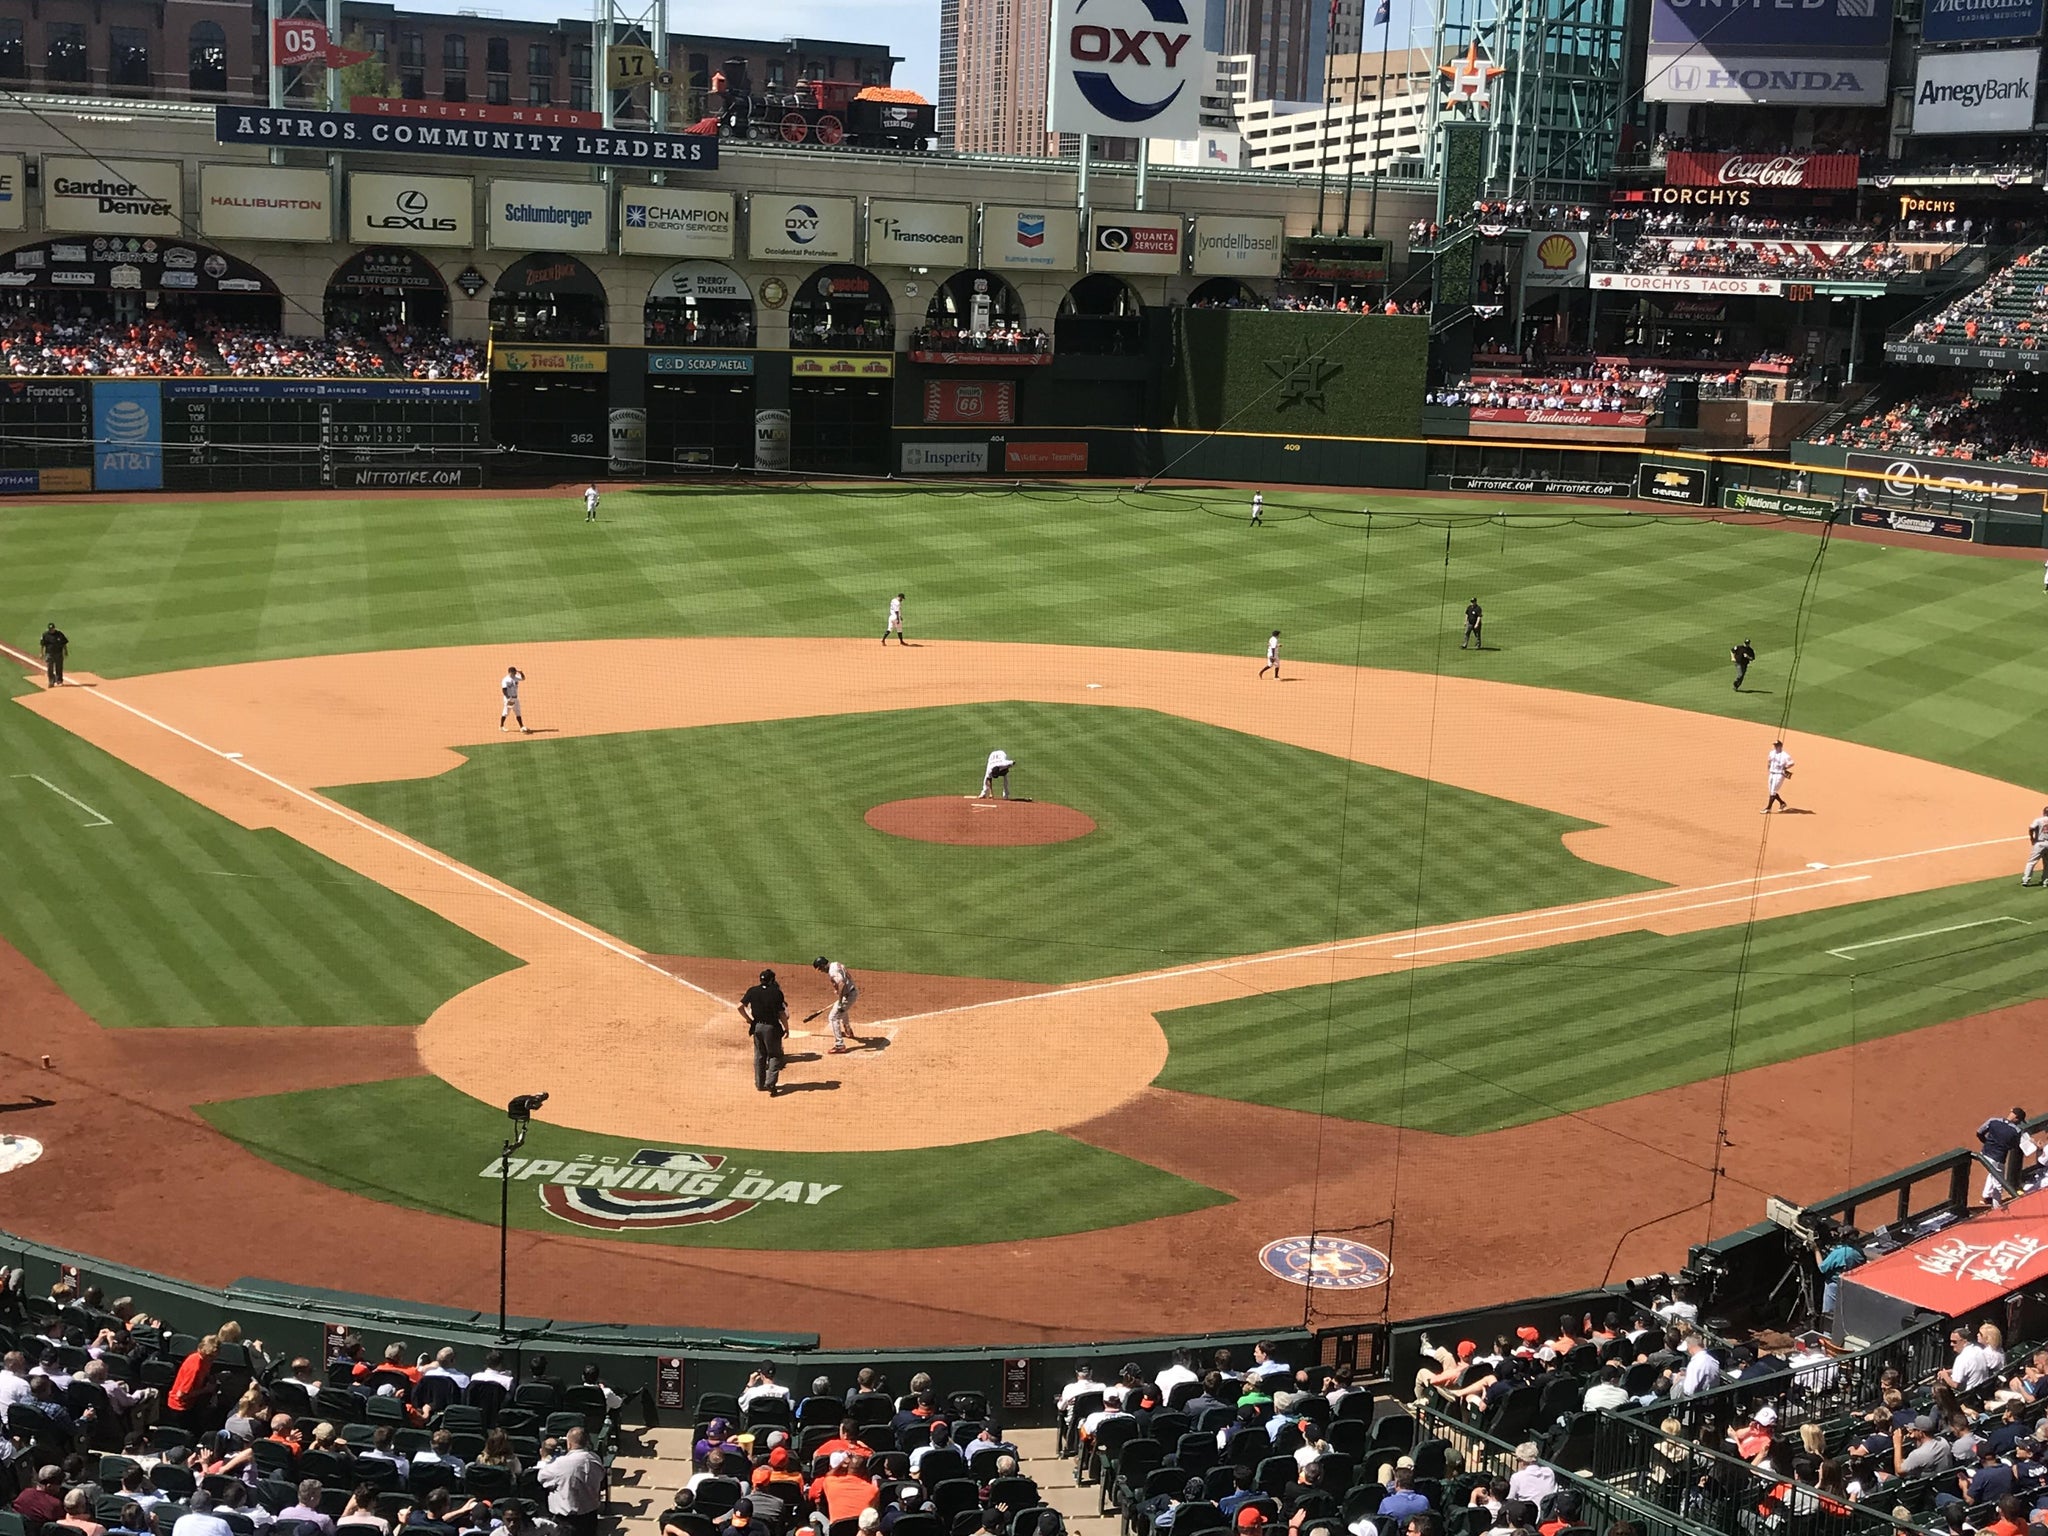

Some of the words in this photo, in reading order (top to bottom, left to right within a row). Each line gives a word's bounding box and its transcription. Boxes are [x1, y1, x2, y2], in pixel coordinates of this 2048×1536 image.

[1957, 13, 1990, 22] LEADING
[285, 29, 316, 52] 05
[1070, 25, 1192, 68] OXY
[618, 55, 643, 77] 17
[1706, 69, 1864, 92] HONDA
[1918, 77, 2030, 107] AmegyBank
[378, 102, 487, 118] MINUTE
[513, 111, 578, 123] MAID
[237, 116, 356, 140] ASTROS
[371, 124, 563, 152] COMMUNITY
[577, 137, 702, 161] LEADERS
[53, 177, 138, 196] Gardner
[211, 196, 322, 211] HALLIBURTON
[1651, 187, 1751, 206] TORCHYS
[98, 198, 172, 216] Denver
[648, 206, 729, 223] CHAMPION
[1900, 196, 1956, 218] TORCHYS
[366, 215, 457, 232] LEXUS
[505, 204, 593, 228] Schlumberger
[1017, 212, 1045, 221] Chevron
[648, 221, 686, 231] ENERGY
[686, 223, 728, 233] SERVICES
[785, 219, 819, 231] OXY
[891, 229, 964, 244] Transocean
[1134, 231, 1175, 242] QUANTA
[1198, 232, 1278, 252] lyondellbasell
[765, 247, 803, 257] Occidental
[803, 249, 838, 258] Petroleum
[1134, 241, 1174, 251] SERVICES
[697, 276, 728, 286] ENERGY
[1623, 277, 1691, 291] TORCHYS
[1702, 280, 1749, 292] TACOS
[697, 286, 737, 295] TRANSFER
[530, 353, 565, 373] Fiesta
[1917, 354, 1936, 364] 0.00
[1954, 357, 1961, 365] 0
[1988, 359, 1994, 368] 0
[2024, 361, 2030, 370] 0
[1979, 350, 2006, 358] STRIKES
[2018, 353, 2040, 361] TOTAL
[570, 361, 594, 370] Fresh
[688, 359, 717, 369] SCRAP
[718, 360, 747, 370] METAL
[26, 385, 75, 397] Fanatics
[188, 404, 206, 412] CWS
[960, 398, 978, 411] 66
[189, 413, 205, 421] TOR
[1524, 409, 1592, 425] Budweiser
[81, 426, 88, 434] 0
[190, 425, 206, 433] CLE
[612, 428, 641, 439] WM
[758, 429, 786, 439] WM
[189, 435, 204, 443] LAA
[322, 407, 330, 481] AMERCAN
[571, 433, 594, 443] 362
[103, 453, 152, 470] AT&T
[189, 456, 204, 464] DET
[925, 450, 984, 467] Insperity
[355, 469, 461, 485] NITTOTIRE.COM
[1467, 480, 1534, 491] NITTOTIRE.COM
[1545, 483, 1613, 495] NITTOTIRE.COM
[1652, 487, 1691, 499] CHEVROLET
[1924, 474, 2019, 501] LEXUS
[1745, 496, 1780, 510] National
[1782, 503, 1796, 512] Car
[1899, 515, 1935, 529] Germania
[574, 1153, 620, 1165] 20
[478, 1157, 726, 1196] OPENING
[728, 1176, 844, 1206] DAY
[1275, 1240, 1355, 1254] ASTROS
